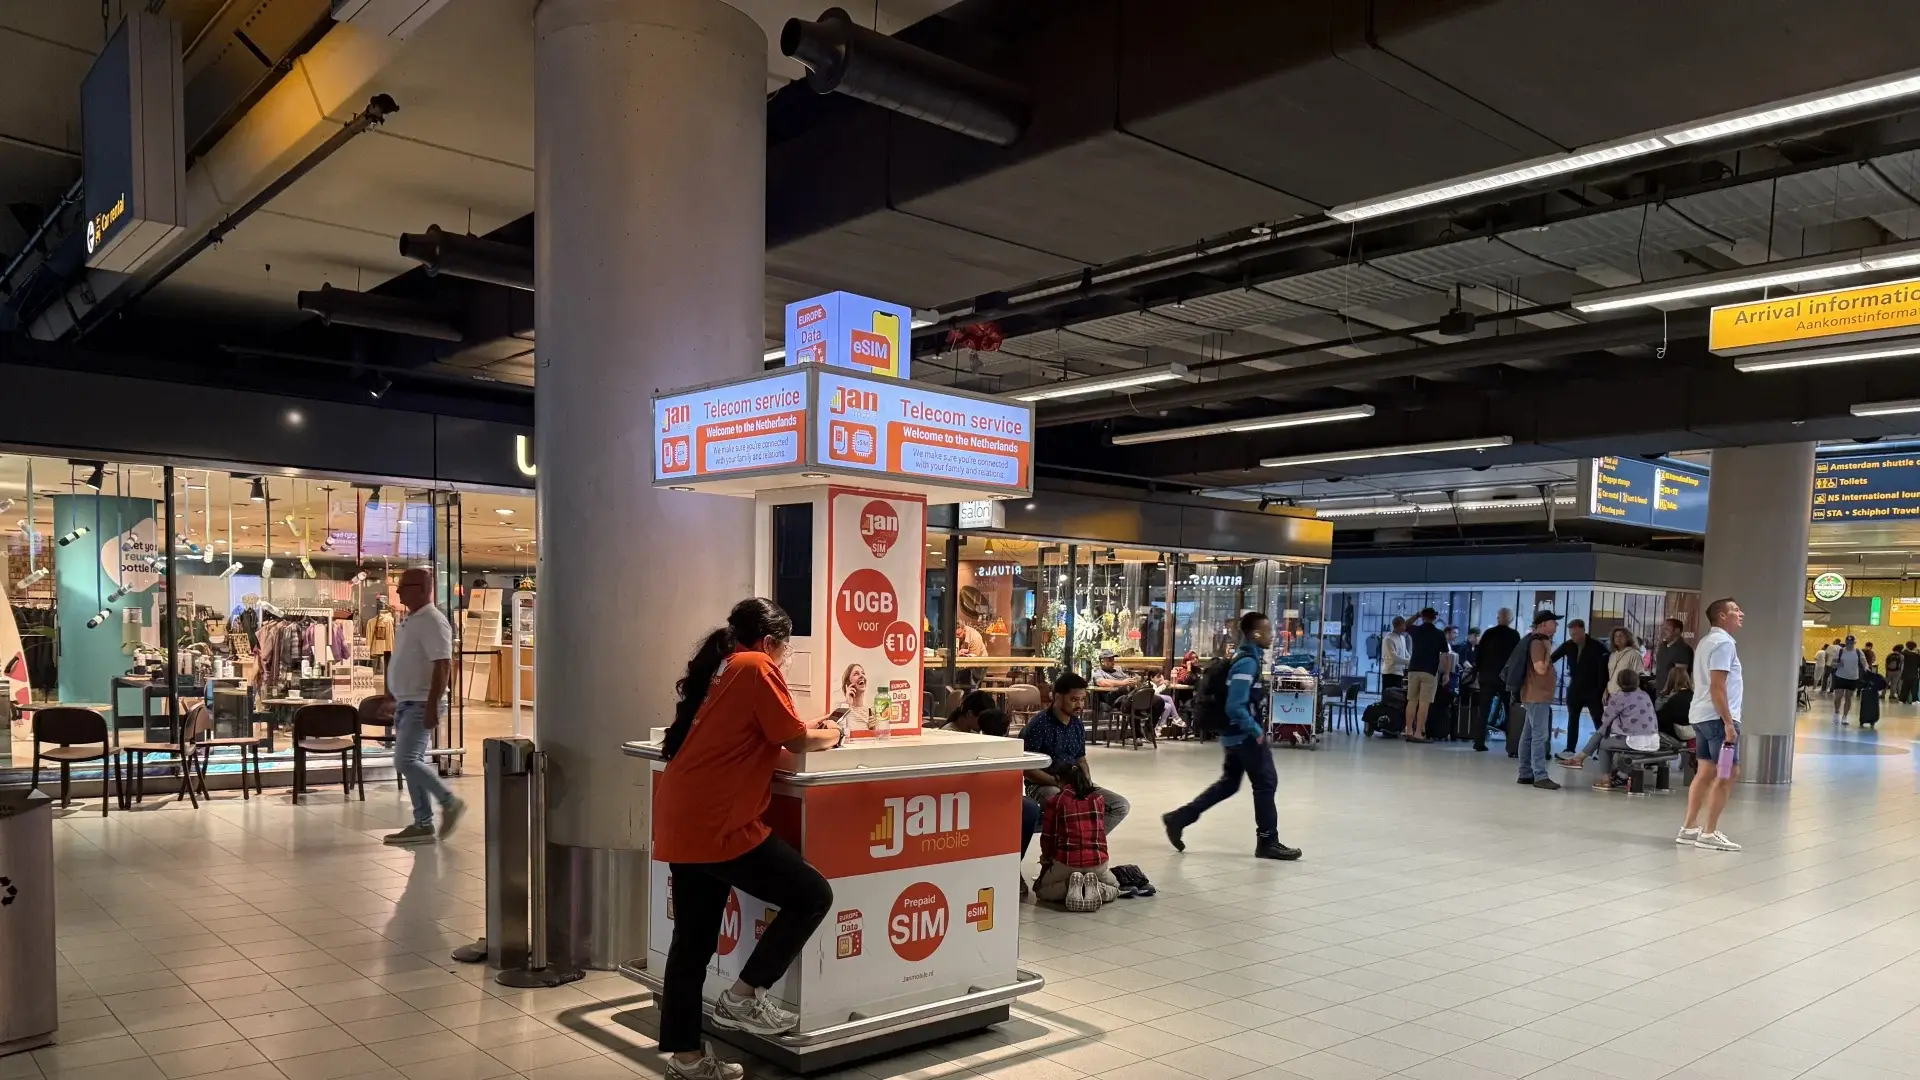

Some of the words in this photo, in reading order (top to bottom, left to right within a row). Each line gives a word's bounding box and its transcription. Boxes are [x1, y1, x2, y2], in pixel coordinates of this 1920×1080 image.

[798, 308, 822, 325] EUROPE
[1735, 302, 1800, 325] Arrival
[1796, 308, 1920, 331] Aankomstinforma
[802, 330, 821, 344] Data
[854, 339, 888, 359] eSIM
[704, 398, 752, 419] Telecom
[756, 388, 800, 411] service
[900, 398, 966, 427] Telecom
[970, 412, 1022, 436] service
[706, 425, 734, 438] Welcome
[736, 423, 742, 433] to
[744, 421, 754, 432] the
[756, 414, 797, 431] Netherlands
[762, 436, 788, 450] connected
[903, 426, 942, 441] Welcome
[945, 433, 954, 444] to
[955, 434, 969, 446] the
[970, 436, 1018, 454] Netherlands
[913, 448, 923, 457] We
[924, 450, 942, 460] make
[958, 454, 976, 466] you're
[977, 457, 1008, 469] connected
[1830, 462, 1880, 470] Amsterdam
[1882, 459, 1914, 468] shuttle
[915, 460, 929, 470] with
[930, 463, 945, 473] your
[946, 463, 964, 476] family
[966, 466, 977, 476] and
[1842, 491, 1899, 501] International
[962, 506, 990, 519] salon
[1852, 508, 1890, 517] Schiphol
[1892, 506, 1919, 515] Travel
[872, 543, 886, 553] SIM
[842, 590, 893, 613] 10GB
[858, 622, 879, 631] voor
[886, 634, 916, 652] €10
[892, 692, 907, 700] Data
[922, 831, 970, 852] mobile
[904, 894, 936, 908] Prepaid
[840, 912, 859, 921] EUROPE
[968, 906, 987, 918] eSIM
[841, 924, 858, 932] Data
[892, 908, 945, 945] SIM
